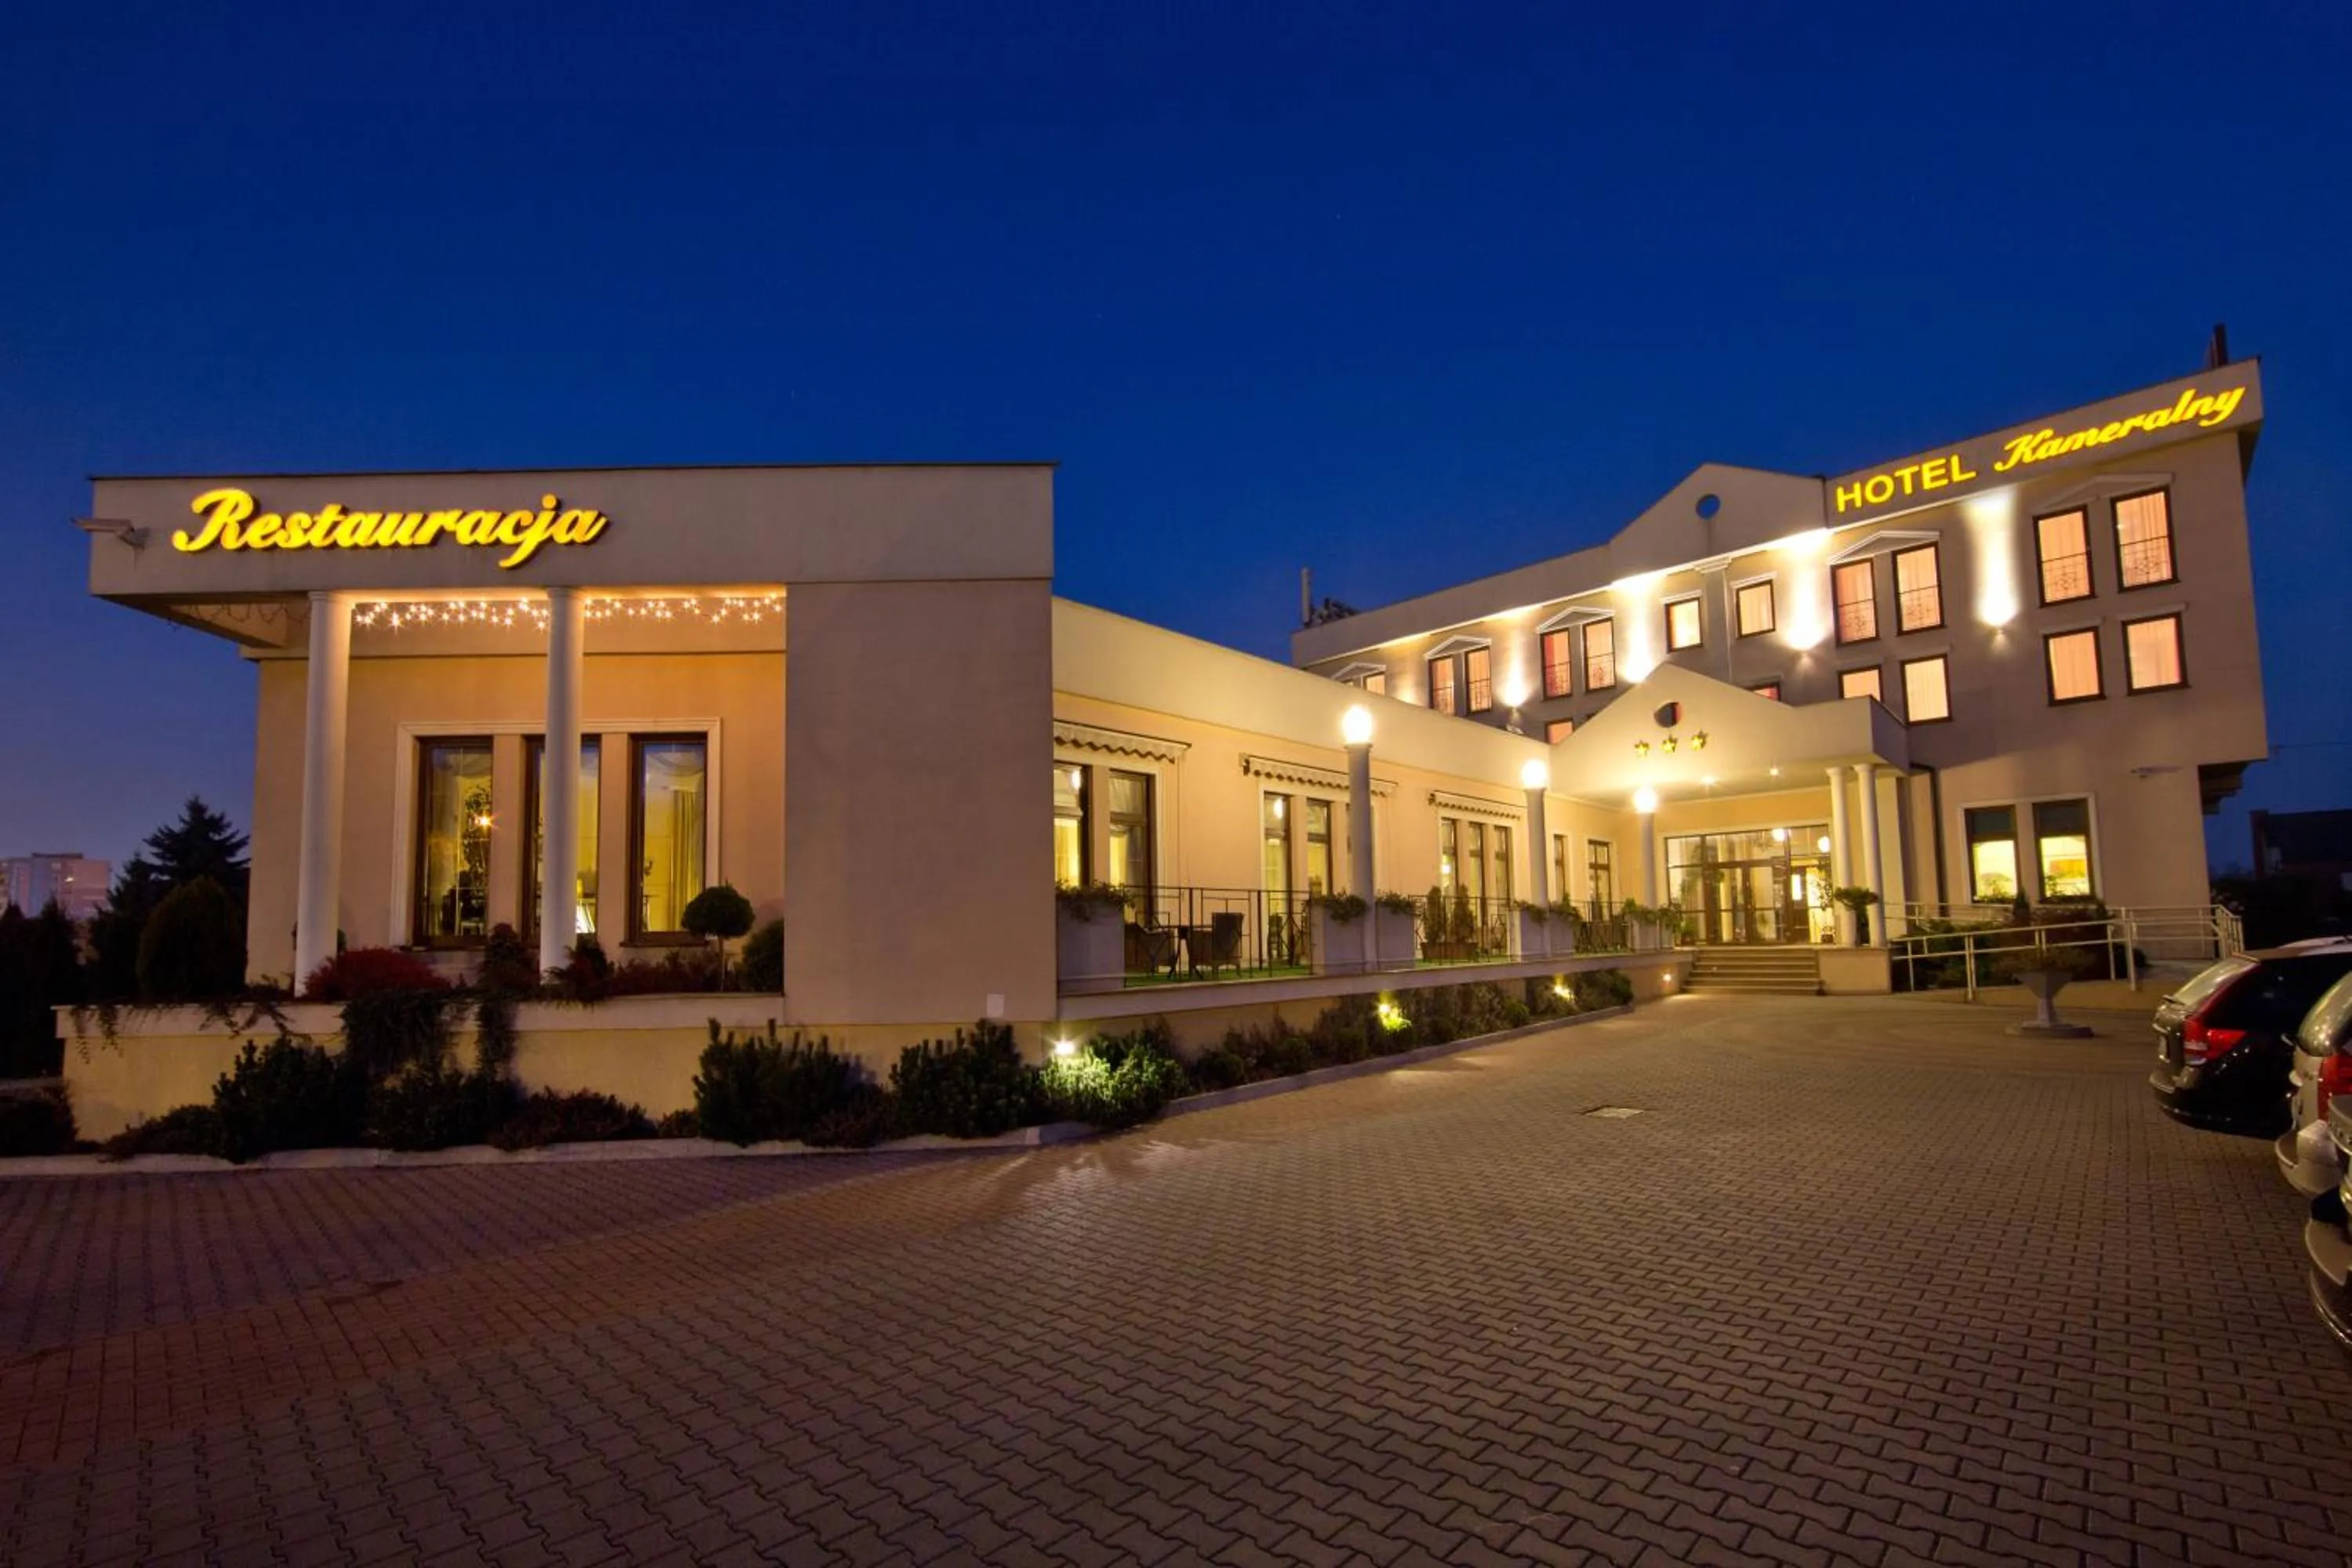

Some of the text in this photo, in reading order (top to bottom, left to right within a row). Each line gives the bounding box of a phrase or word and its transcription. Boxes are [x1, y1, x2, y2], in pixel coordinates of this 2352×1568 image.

[1835, 387, 2246, 513] HOTEL Kameralny
[172, 488, 607, 568] Restauracja
